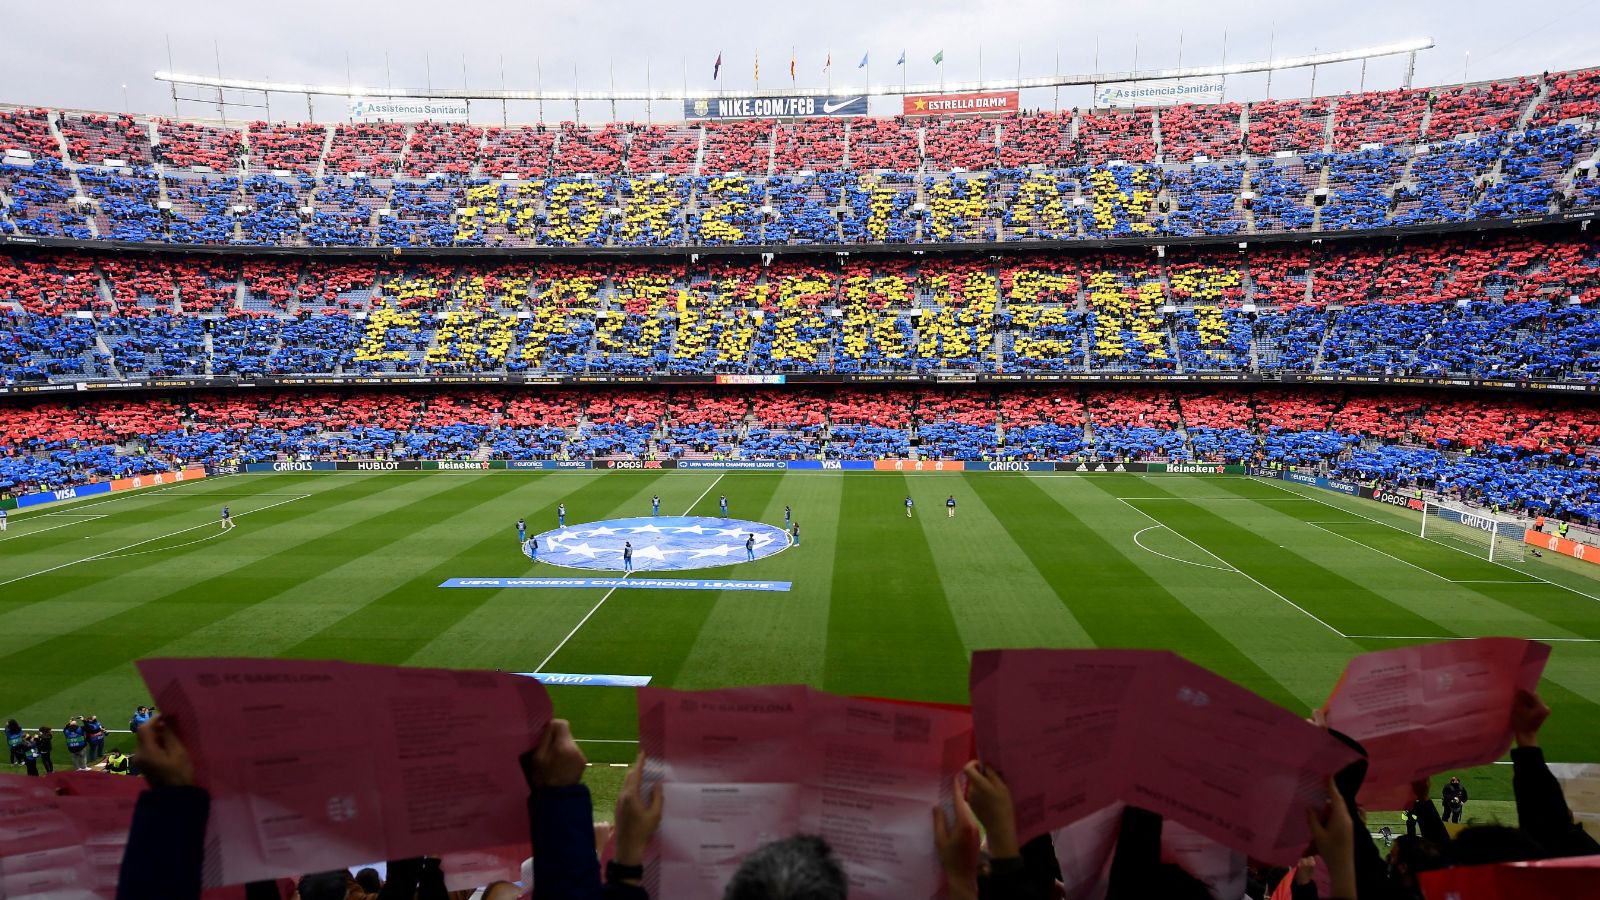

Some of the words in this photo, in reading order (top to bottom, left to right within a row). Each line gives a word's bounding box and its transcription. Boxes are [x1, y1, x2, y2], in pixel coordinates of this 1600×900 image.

[719, 98, 814, 116] NIKE.COM/FCB
[928, 100, 973, 110] ESTRELLA
[976, 97, 1006, 108] DAMM
[273, 462, 312, 471] GRIFOLS
[358, 462, 399, 470] HUBLOT
[438, 461, 481, 470] Heineken
[617, 460, 643, 469] pepsi
[821, 460, 842, 469] VISA
[989, 461, 1030, 471] GRIFOLS
[1166, 464, 1216, 473] Heineken
[1293, 474, 1316, 484] euronics
[1330, 481, 1354, 491] euronics
[53, 488, 77, 500] VISA
[1381, 492, 1408, 506] pepsi
[591, 580, 698, 588] CHAMPIONS
[243, 673, 334, 683] BARCELONA
[545, 675, 593, 684] МИР
[719, 702, 794, 714] BARCELONA
